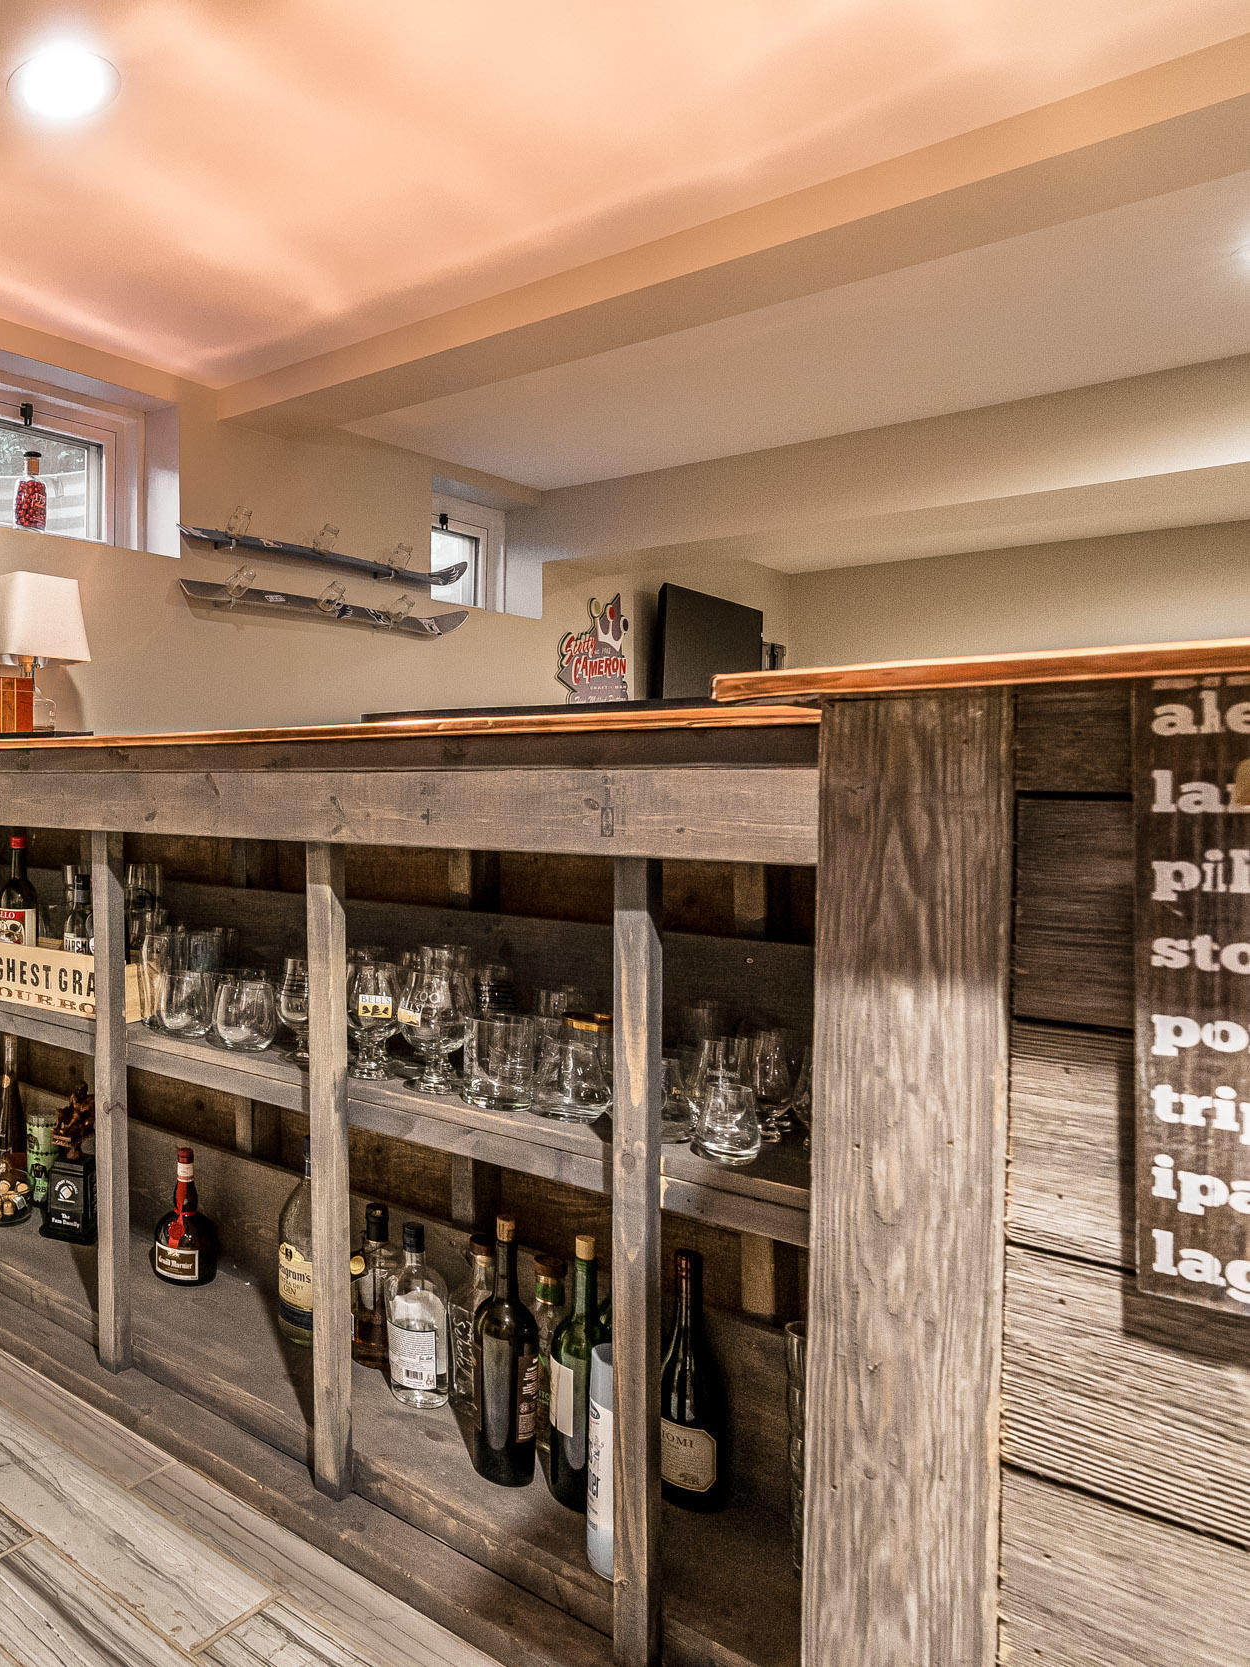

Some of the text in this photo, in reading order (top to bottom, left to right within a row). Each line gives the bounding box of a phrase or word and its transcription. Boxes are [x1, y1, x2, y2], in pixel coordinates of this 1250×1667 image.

[564, 634, 597, 668] Scotty
[572, 655, 627, 686] CAMERON
[58, 967, 95, 998] GRA
[1150, 1013, 1250, 1057] po
[1150, 1084, 1250, 1146] tri
